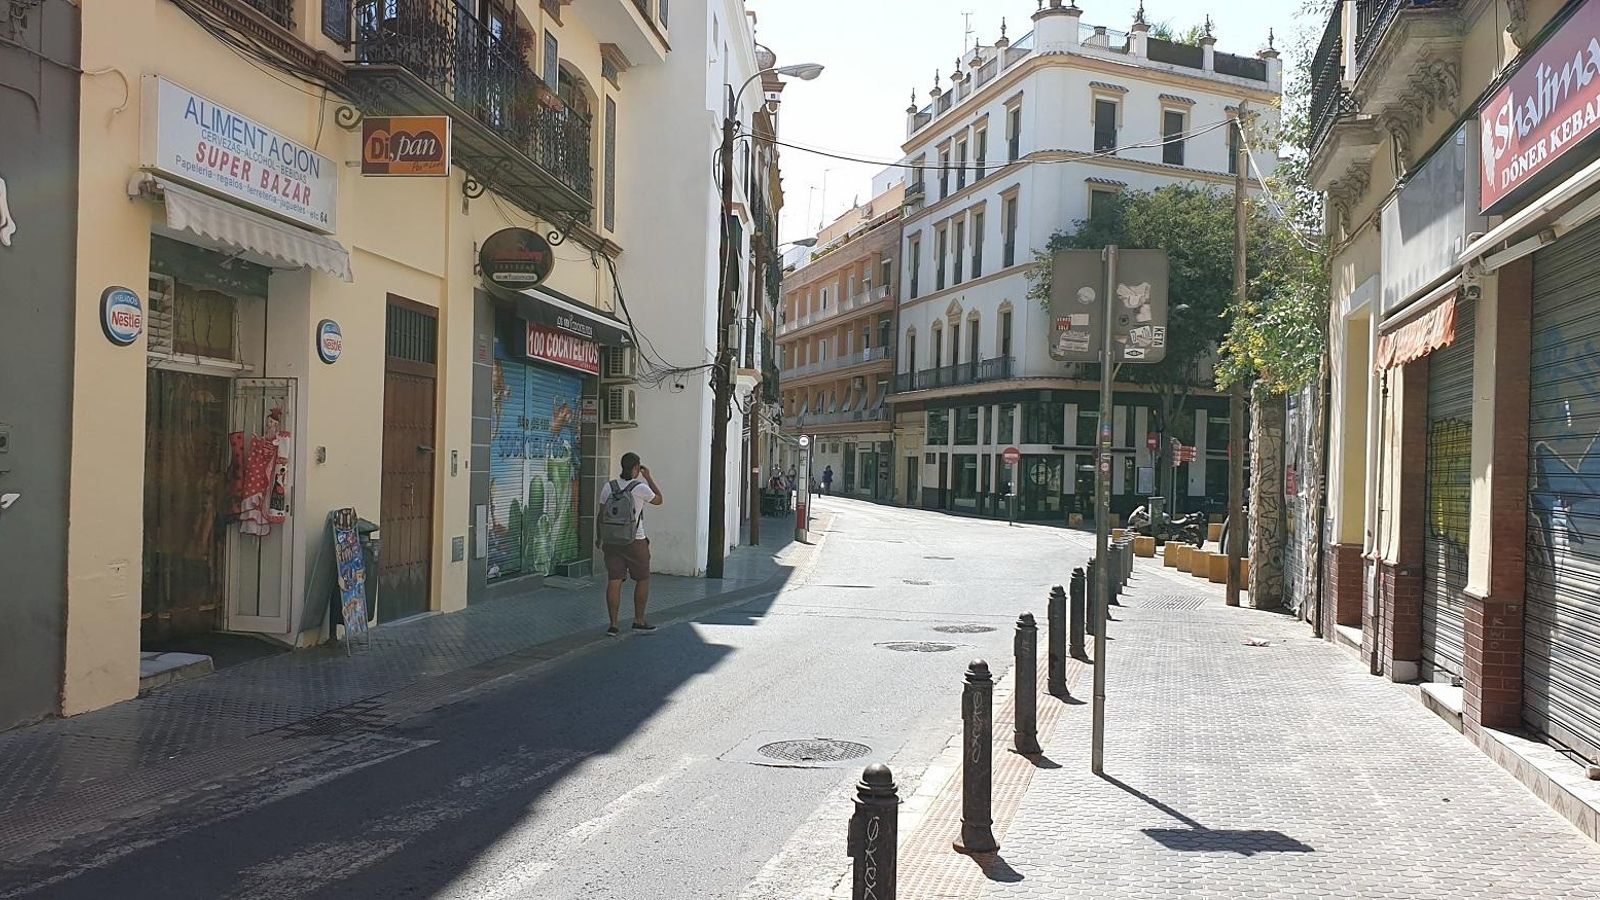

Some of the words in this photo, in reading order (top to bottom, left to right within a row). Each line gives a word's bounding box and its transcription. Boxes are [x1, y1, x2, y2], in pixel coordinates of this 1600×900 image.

[184, 97, 320, 179] ALIMENTACION
[1550, 94, 1600, 153] KEBA
[196, 141, 252, 181] SUPER
[260, 168, 311, 206] BAZAR
[529, 330, 545, 356] 100
